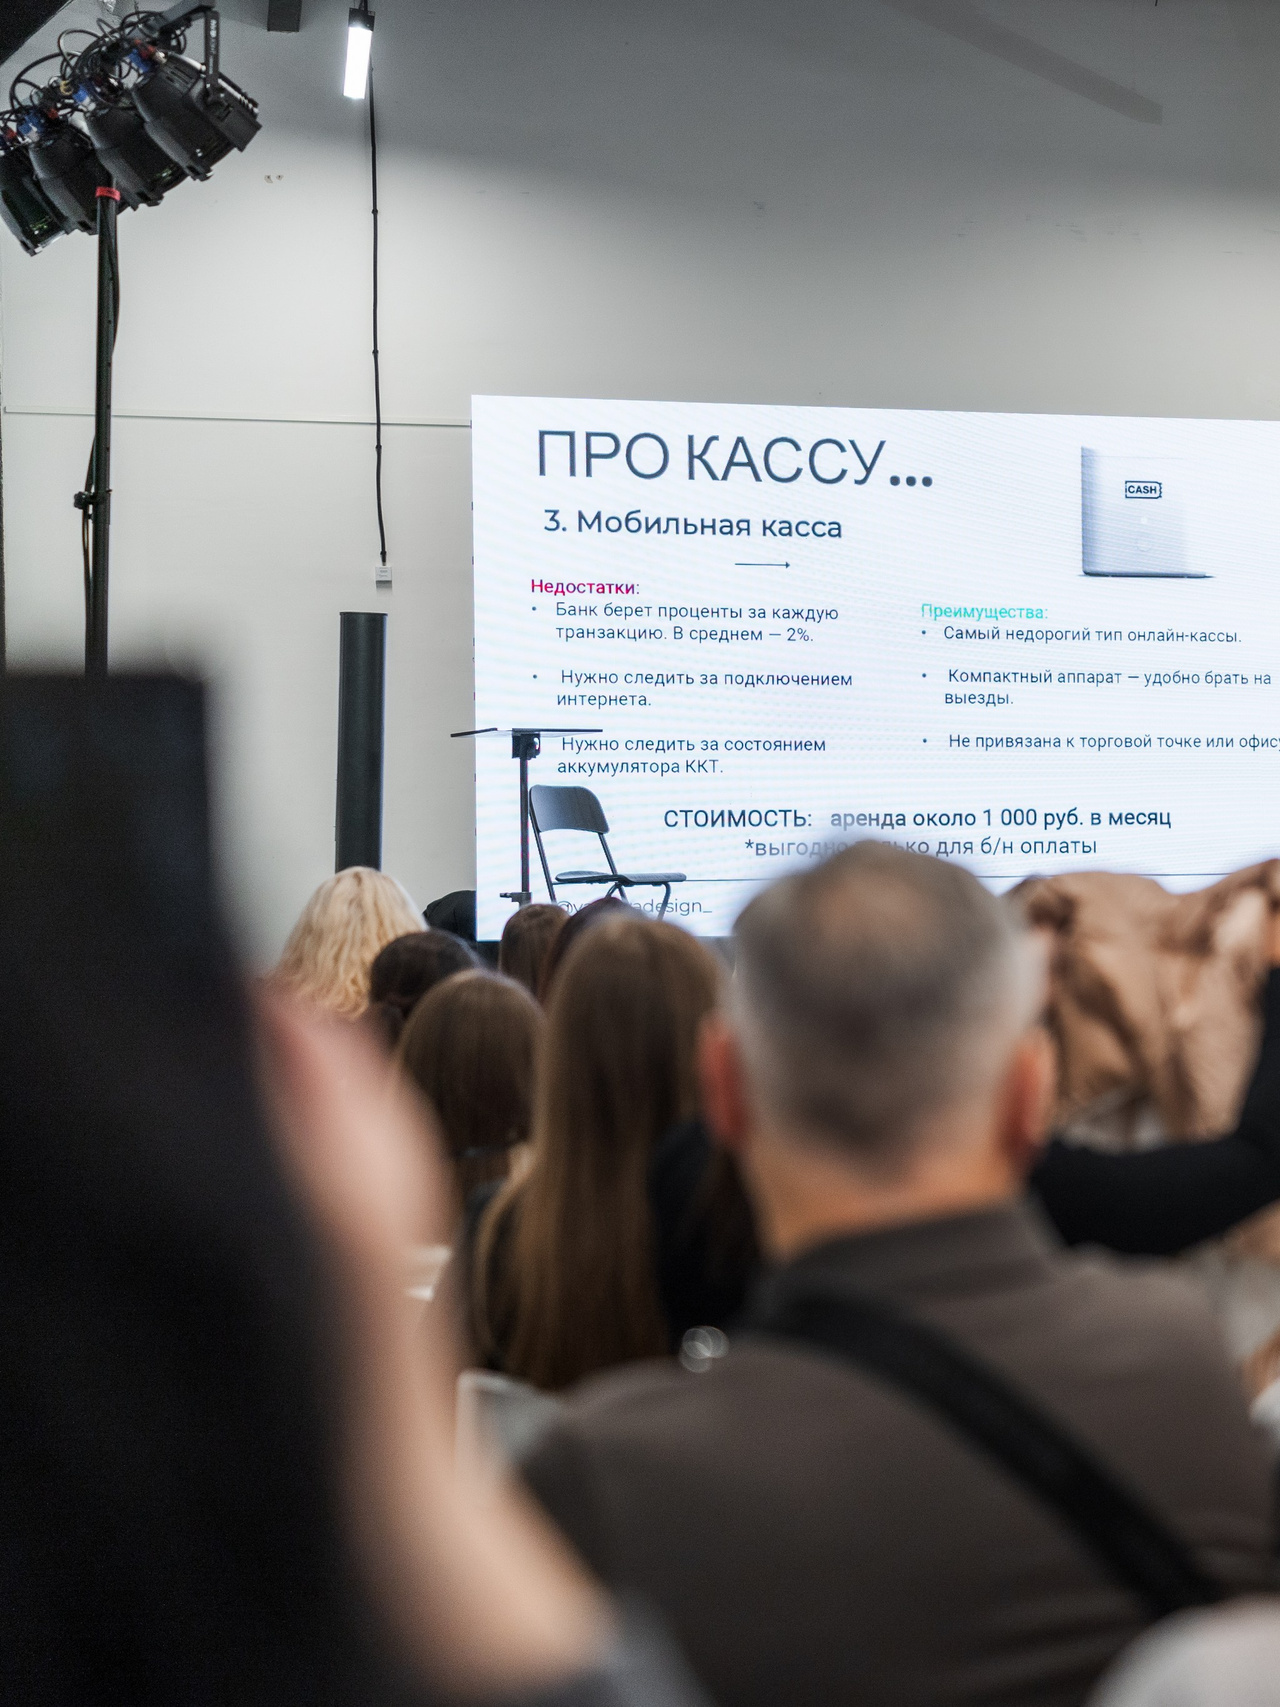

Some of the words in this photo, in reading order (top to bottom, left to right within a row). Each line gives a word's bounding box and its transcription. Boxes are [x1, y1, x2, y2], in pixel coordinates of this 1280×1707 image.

[538, 429, 670, 480] ПРО
[687, 434, 933, 488] КАССУ...
[1126, 484, 1158, 495] CASH
[543, 509, 567, 532] 3.
[577, 509, 751, 537] Мобильная
[762, 519, 842, 539] касса
[531, 578, 640, 597] Недостатки:
[556, 601, 598, 617] Банк
[603, 601, 653, 621] берет
[658, 606, 743, 622] проценты
[748, 607, 767, 619] за
[772, 608, 839, 624] каждую
[920, 603, 1049, 622] Преимущества:
[555, 627, 667, 643] транзакцию.
[673, 625, 684, 640] В
[689, 629, 763, 644] среднем
[786, 627, 814, 642] 2%.
[943, 625, 1000, 640] Самый
[1005, 627, 1091, 645] недорогий
[1094, 630, 1123, 642] тип
[1127, 628, 1242, 643] онлайн-кассы.
[561, 669, 619, 688] Нужно
[623, 672, 695, 687] следить
[699, 673, 718, 685] за
[724, 673, 853, 688] подключением
[948, 668, 1053, 684] Компактный
[1057, 672, 1123, 688] аппарат
[1143, 669, 1201, 688] удобно
[1204, 670, 1249, 688] брать
[1254, 673, 1272, 685] на
[557, 694, 652, 710] интернета.
[944, 692, 1014, 708] выезды.
[562, 736, 620, 755] Нужно
[624, 739, 696, 754] следить
[700, 739, 719, 752] за
[724, 739, 826, 752] состоянием
[949, 734, 971, 748] Не
[975, 736, 1061, 752] привязана
[1066, 736, 1075, 748] к
[1079, 734, 1152, 752] торговой
[1156, 736, 1202, 748] точке
[1206, 737, 1234, 748] или
[557, 761, 680, 778] аккумулятора
[685, 759, 724, 774] ККТ.
[663, 809, 812, 828] СТОИМОСТЬ:
[830, 812, 907, 832] аренда
[912, 812, 977, 827] около
[982, 808, 991, 827] 1
[1000, 808, 1038, 826] 000
[1043, 806, 1084, 831] руб.
[1090, 812, 1102, 826] в
[1108, 811, 1172, 829] месяц
[855, 841, 930, 855] ько
[935, 836, 974, 857] для
[979, 834, 1015, 856] б/н
[1019, 837, 1098, 857] оплаты
